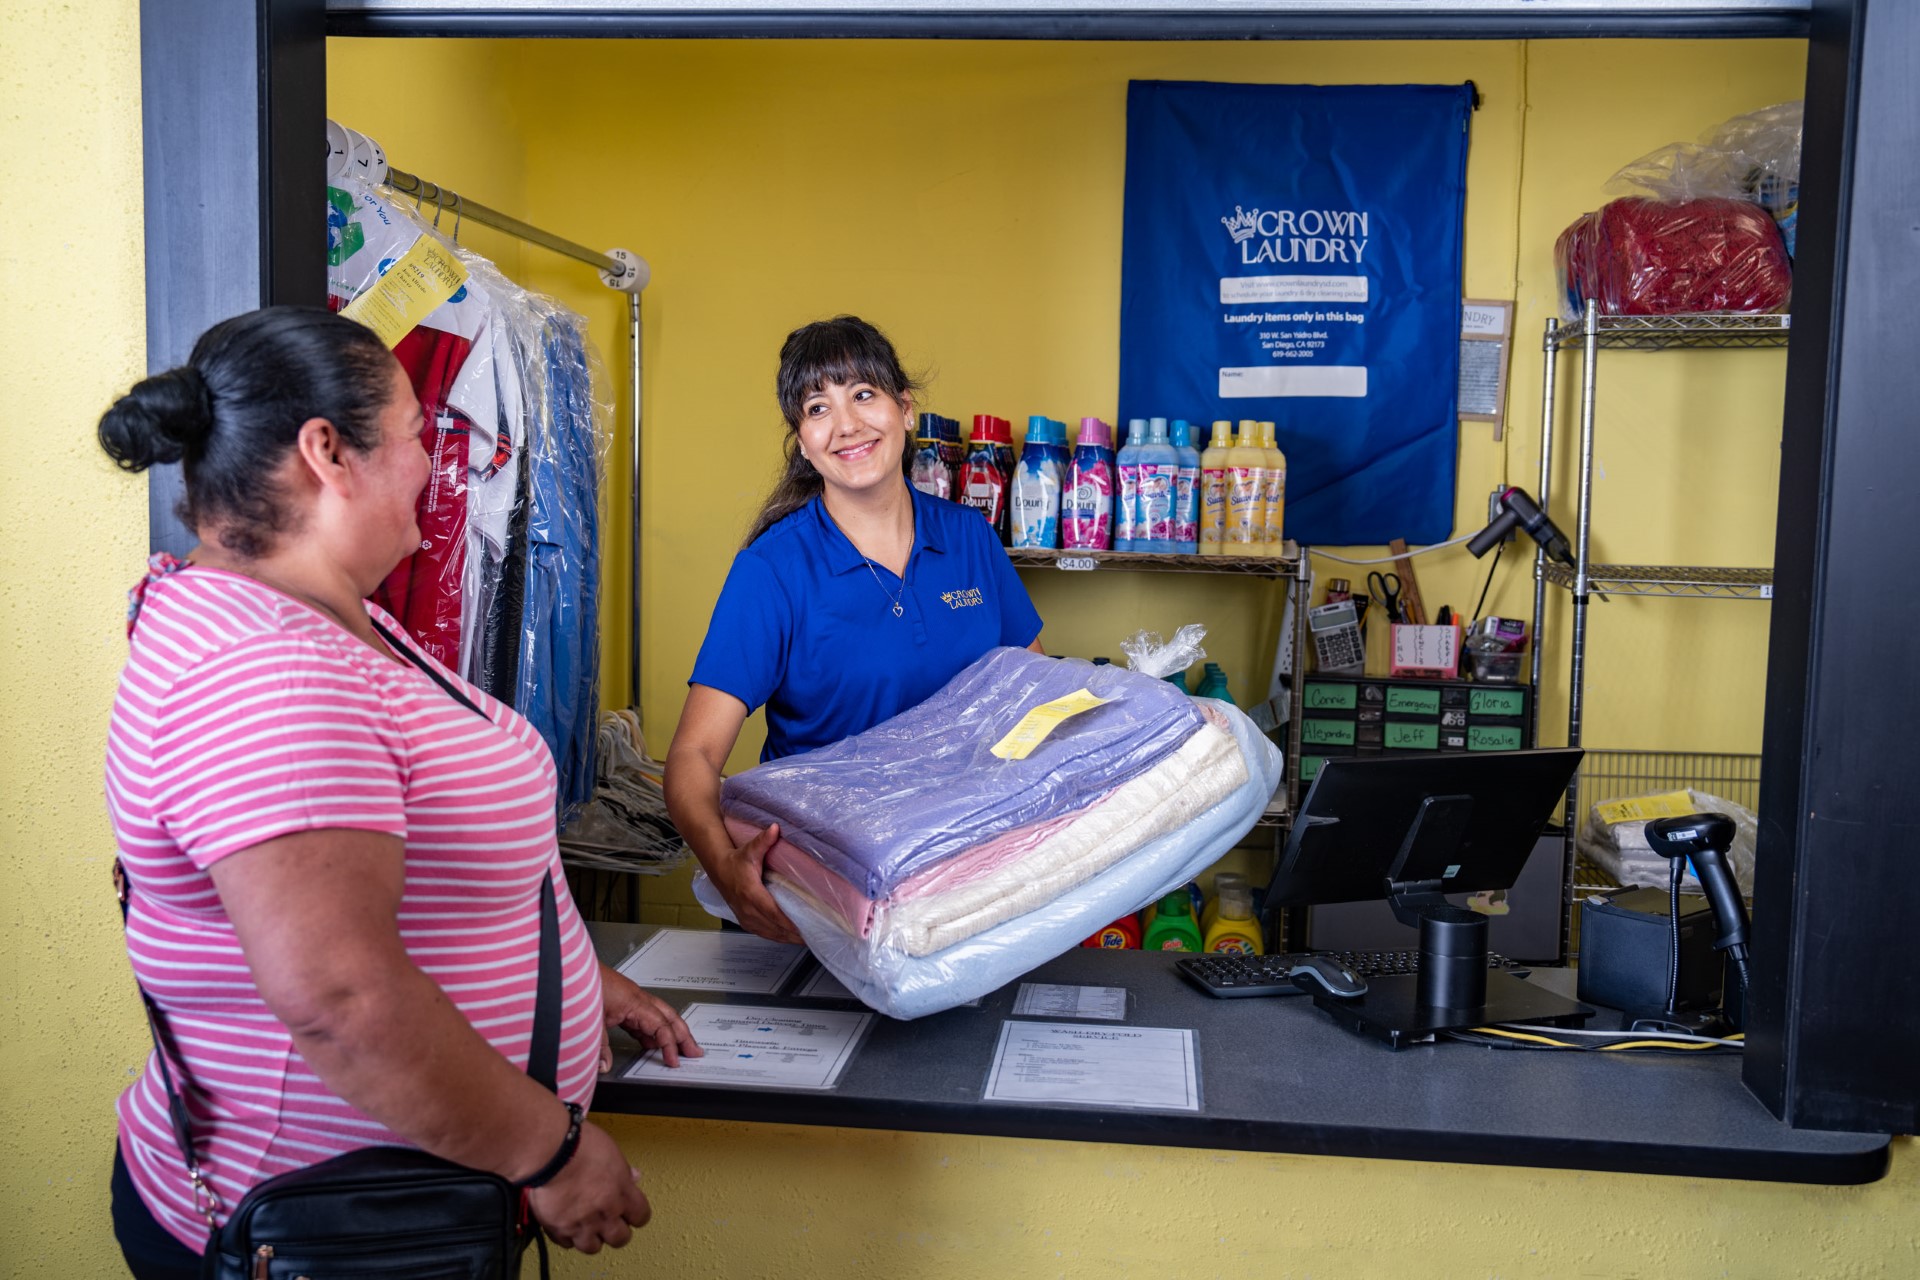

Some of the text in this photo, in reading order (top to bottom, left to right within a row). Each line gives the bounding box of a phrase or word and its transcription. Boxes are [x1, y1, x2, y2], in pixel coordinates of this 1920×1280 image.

[357, 159, 368, 168] 7
[376, 205, 392, 226] You
[1257, 210, 1368, 237] CROWN
[616, 251, 627, 260] 15
[1242, 238, 1368, 264] LAUNDRY
[627, 266, 636, 278] 15
[609, 279, 620, 287] 15
[1224, 311, 1364, 324] Laundry items only in this bag
[1464, 311, 1495, 326] NDRY
[1262, 341, 1274, 349] San
[961, 495, 995, 510] Downy
[1067, 499, 1102, 511] Dwn
[1062, 558, 1091, 570] $4.00
[951, 587, 981, 600] CROWN
[950, 596, 983, 609] LAUNDRY
[1311, 689, 1346, 707] Connie
[1388, 693, 1437, 712] Emergency
[1471, 691, 1512, 711] Gloria
[1393, 728, 1425, 743] Jeff
[1472, 730, 1515, 746] Rosalie
[1103, 934, 1123, 947] Tide
